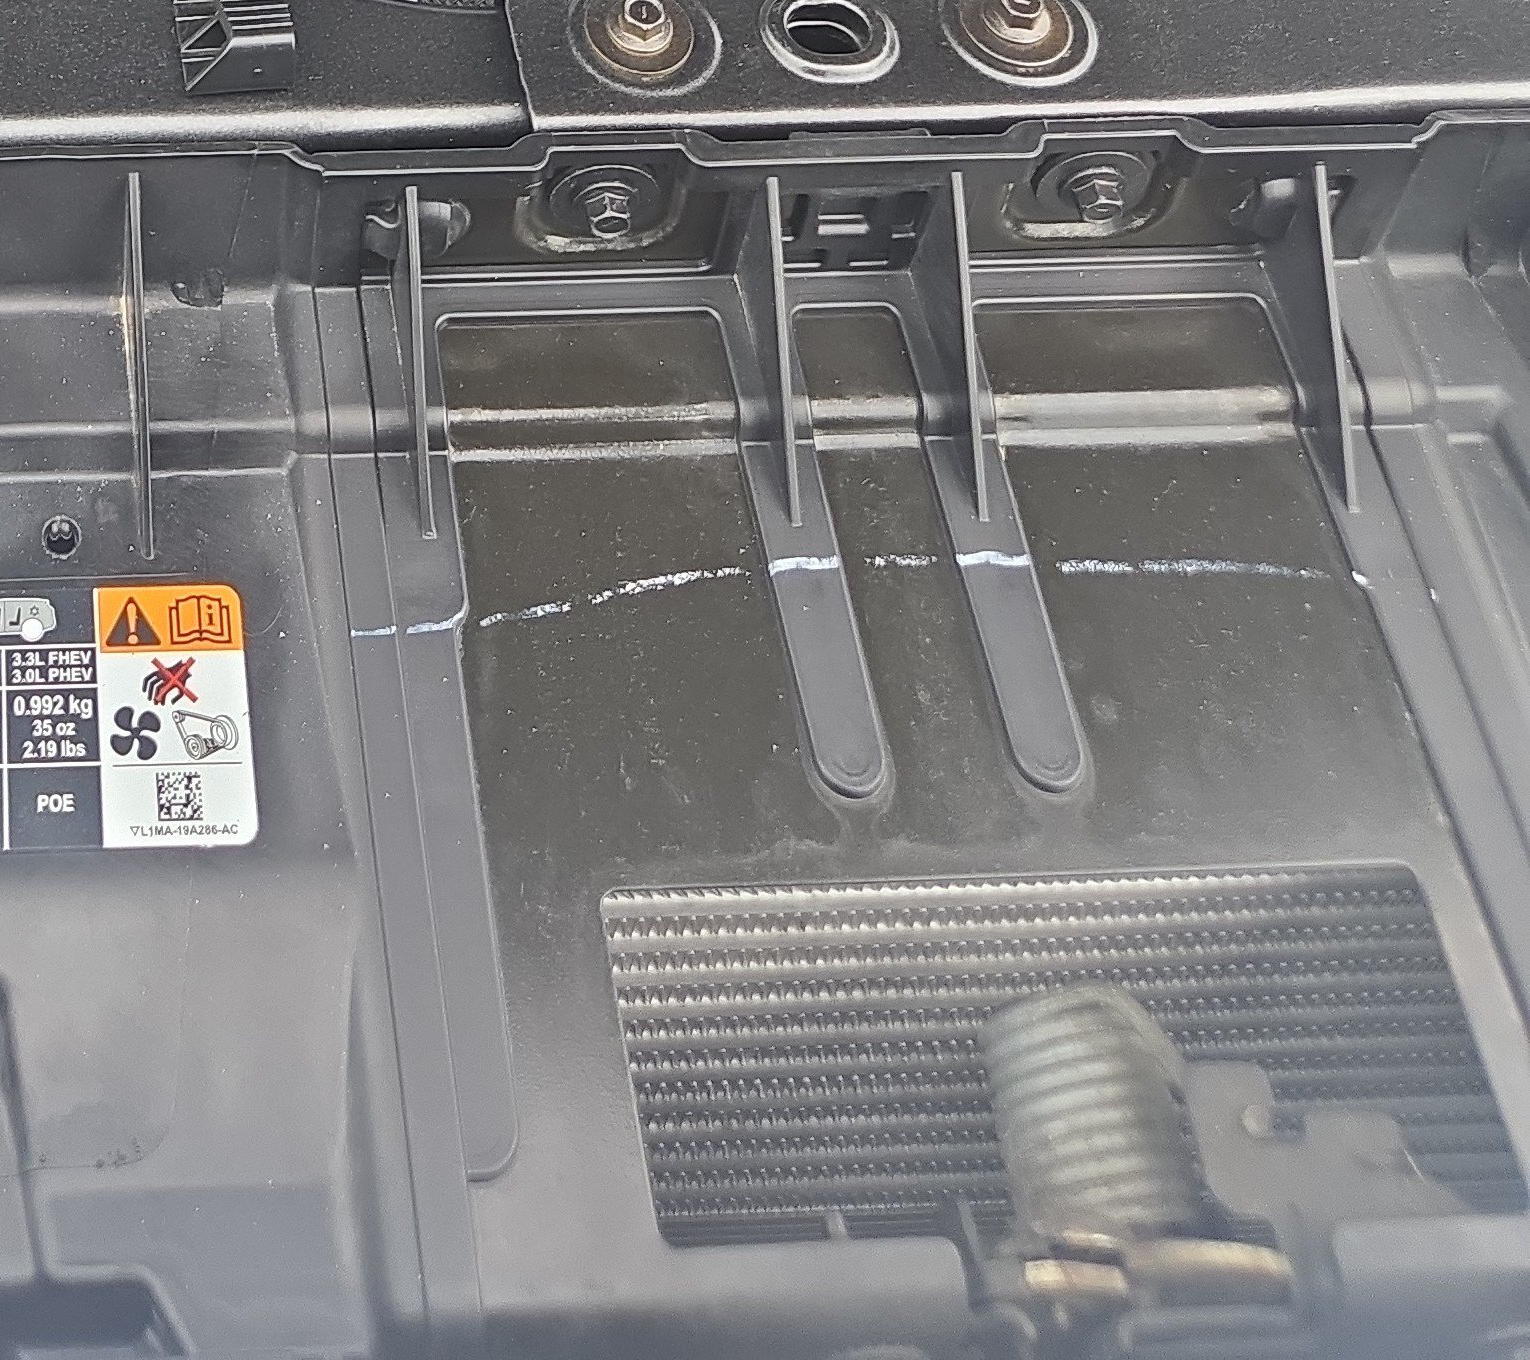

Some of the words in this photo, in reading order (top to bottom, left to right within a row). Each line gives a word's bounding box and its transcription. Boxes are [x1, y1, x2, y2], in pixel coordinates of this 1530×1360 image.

[11, 652, 45, 667] 3.3L
[48, 650, 92, 665] FHEV
[11, 669, 45, 684] 3.0L
[48, 667, 93, 682] PHEV
[13, 695, 65, 716] 0.992
[69, 694, 93, 719] kg
[32, 719, 53, 736] 35
[55, 722, 77, 735] oz
[22, 741, 57, 759] 2.19
[61, 740, 87, 757] lbs
[36, 794, 76, 813] POE
